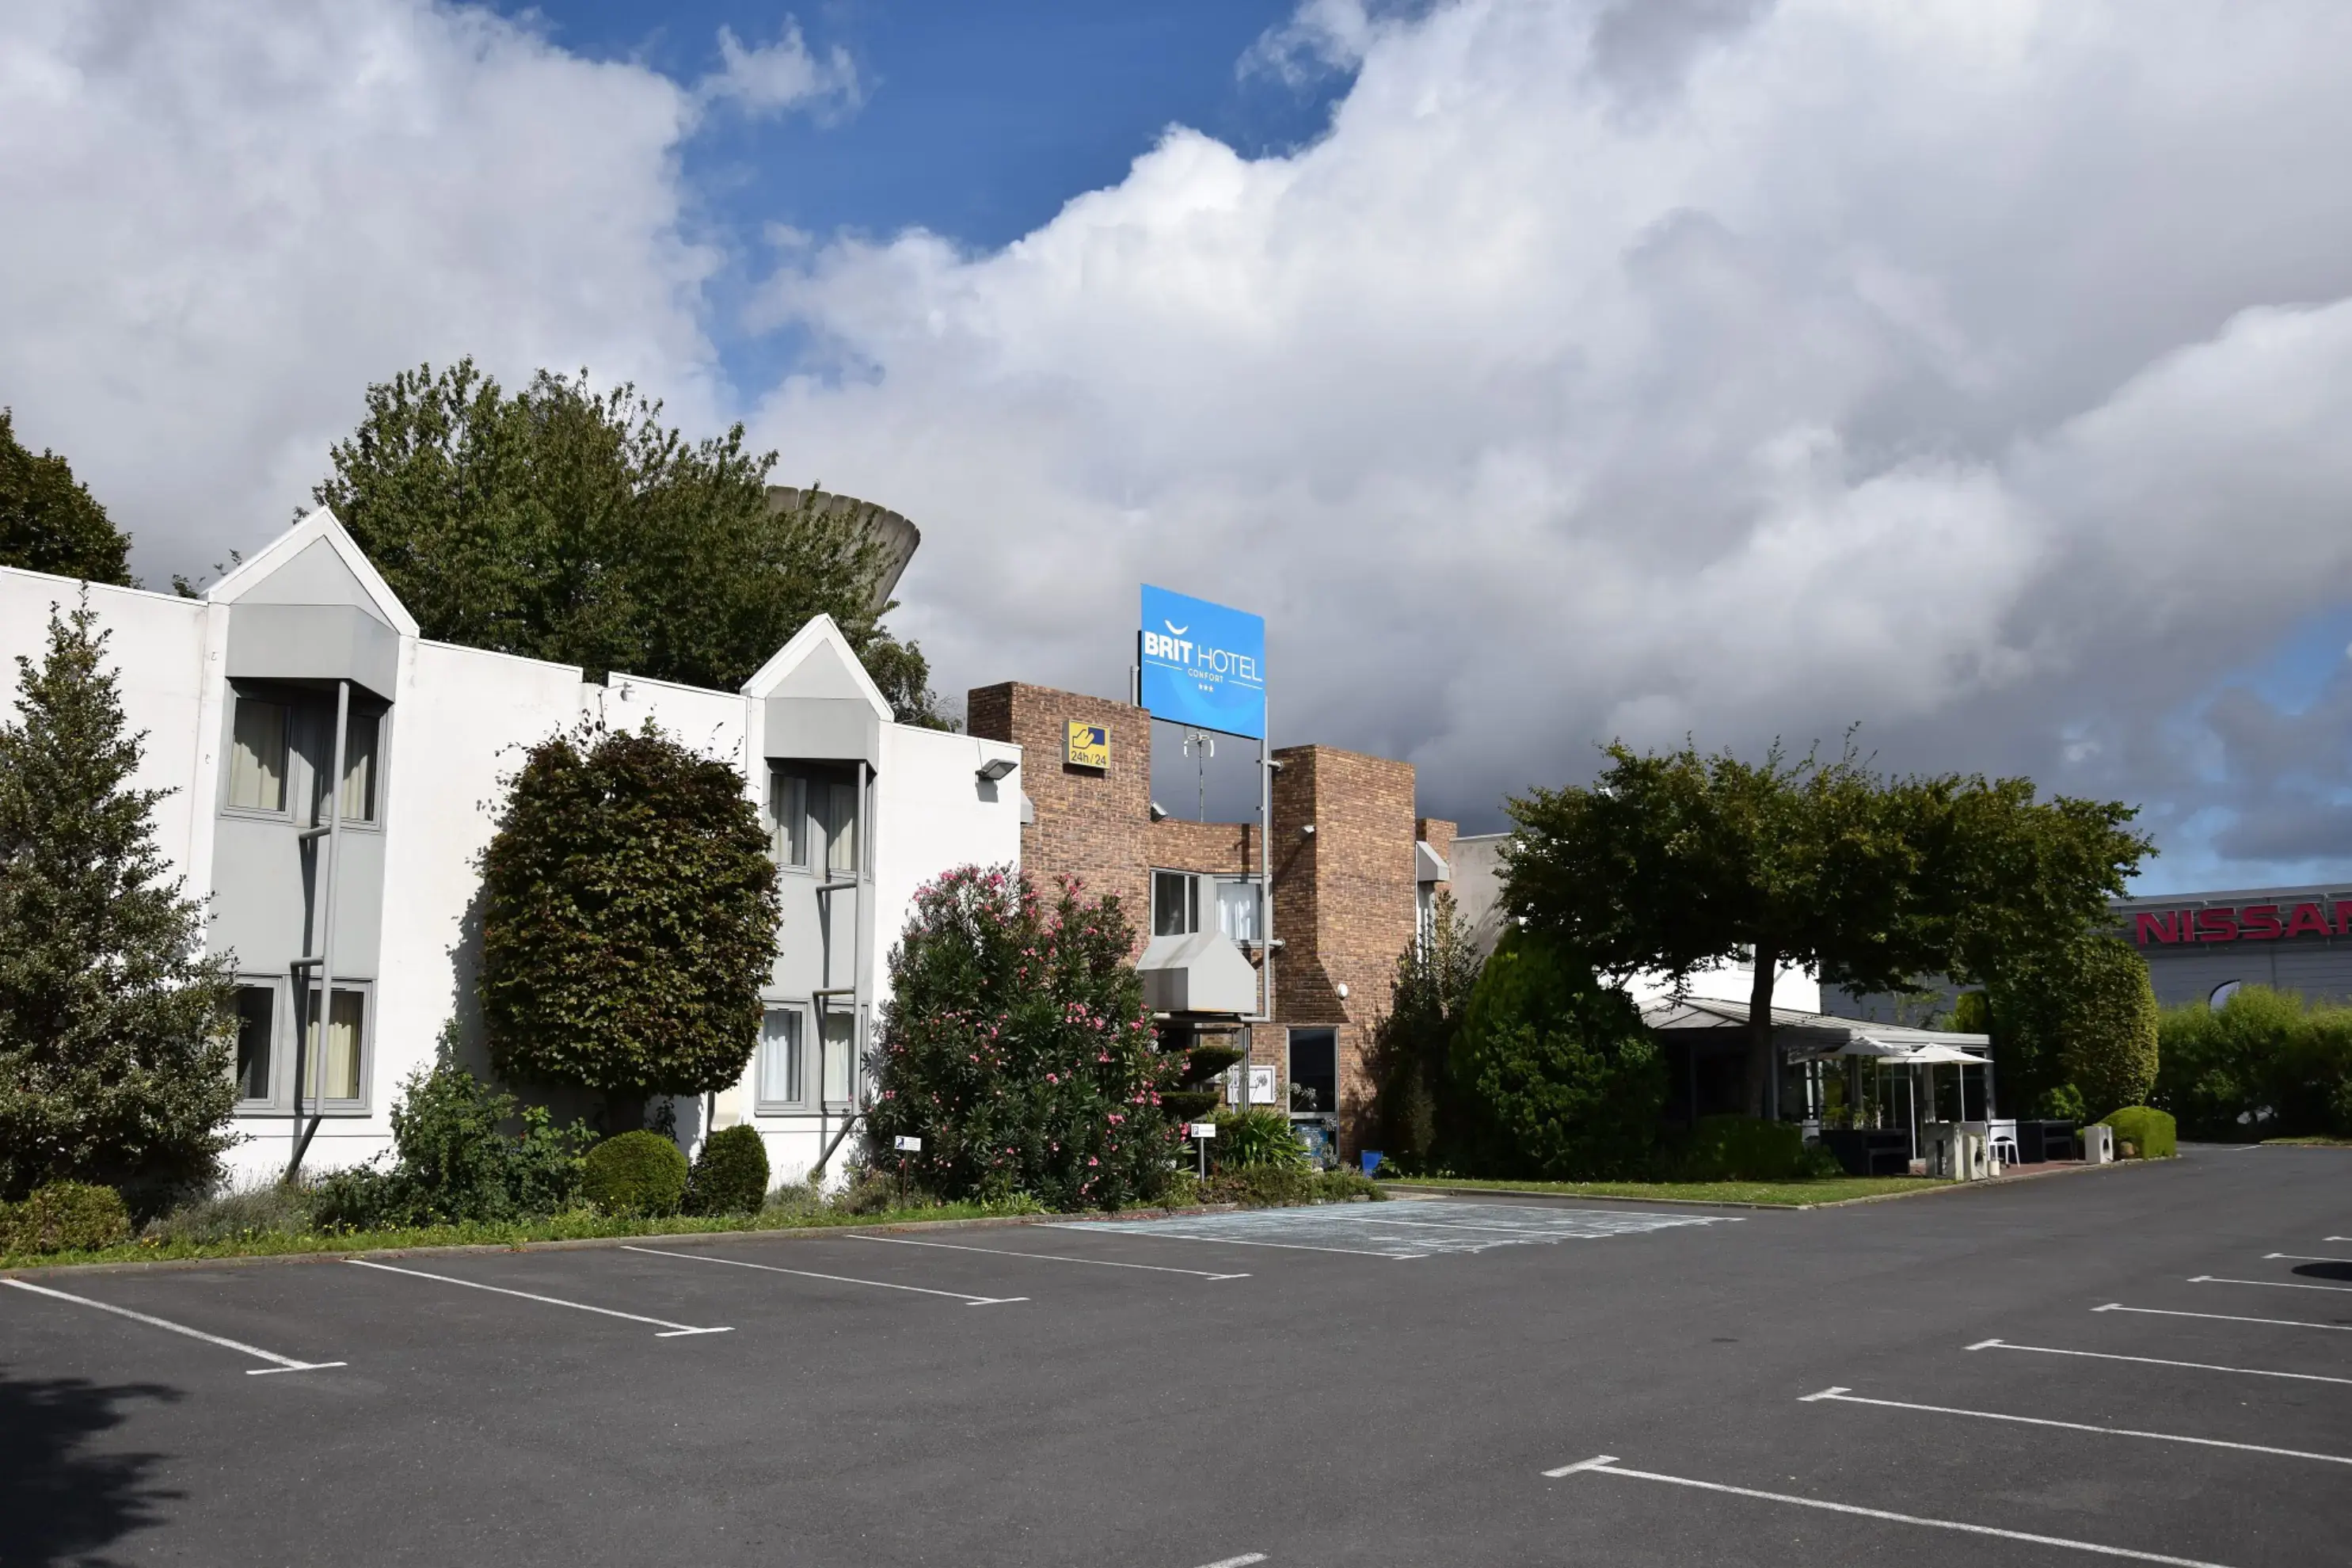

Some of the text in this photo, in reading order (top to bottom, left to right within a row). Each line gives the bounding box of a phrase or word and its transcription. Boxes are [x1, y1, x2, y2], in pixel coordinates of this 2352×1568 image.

[1144, 631, 1262, 682] BRIT HOTEL
[1188, 668, 1224, 683] CONFORT
